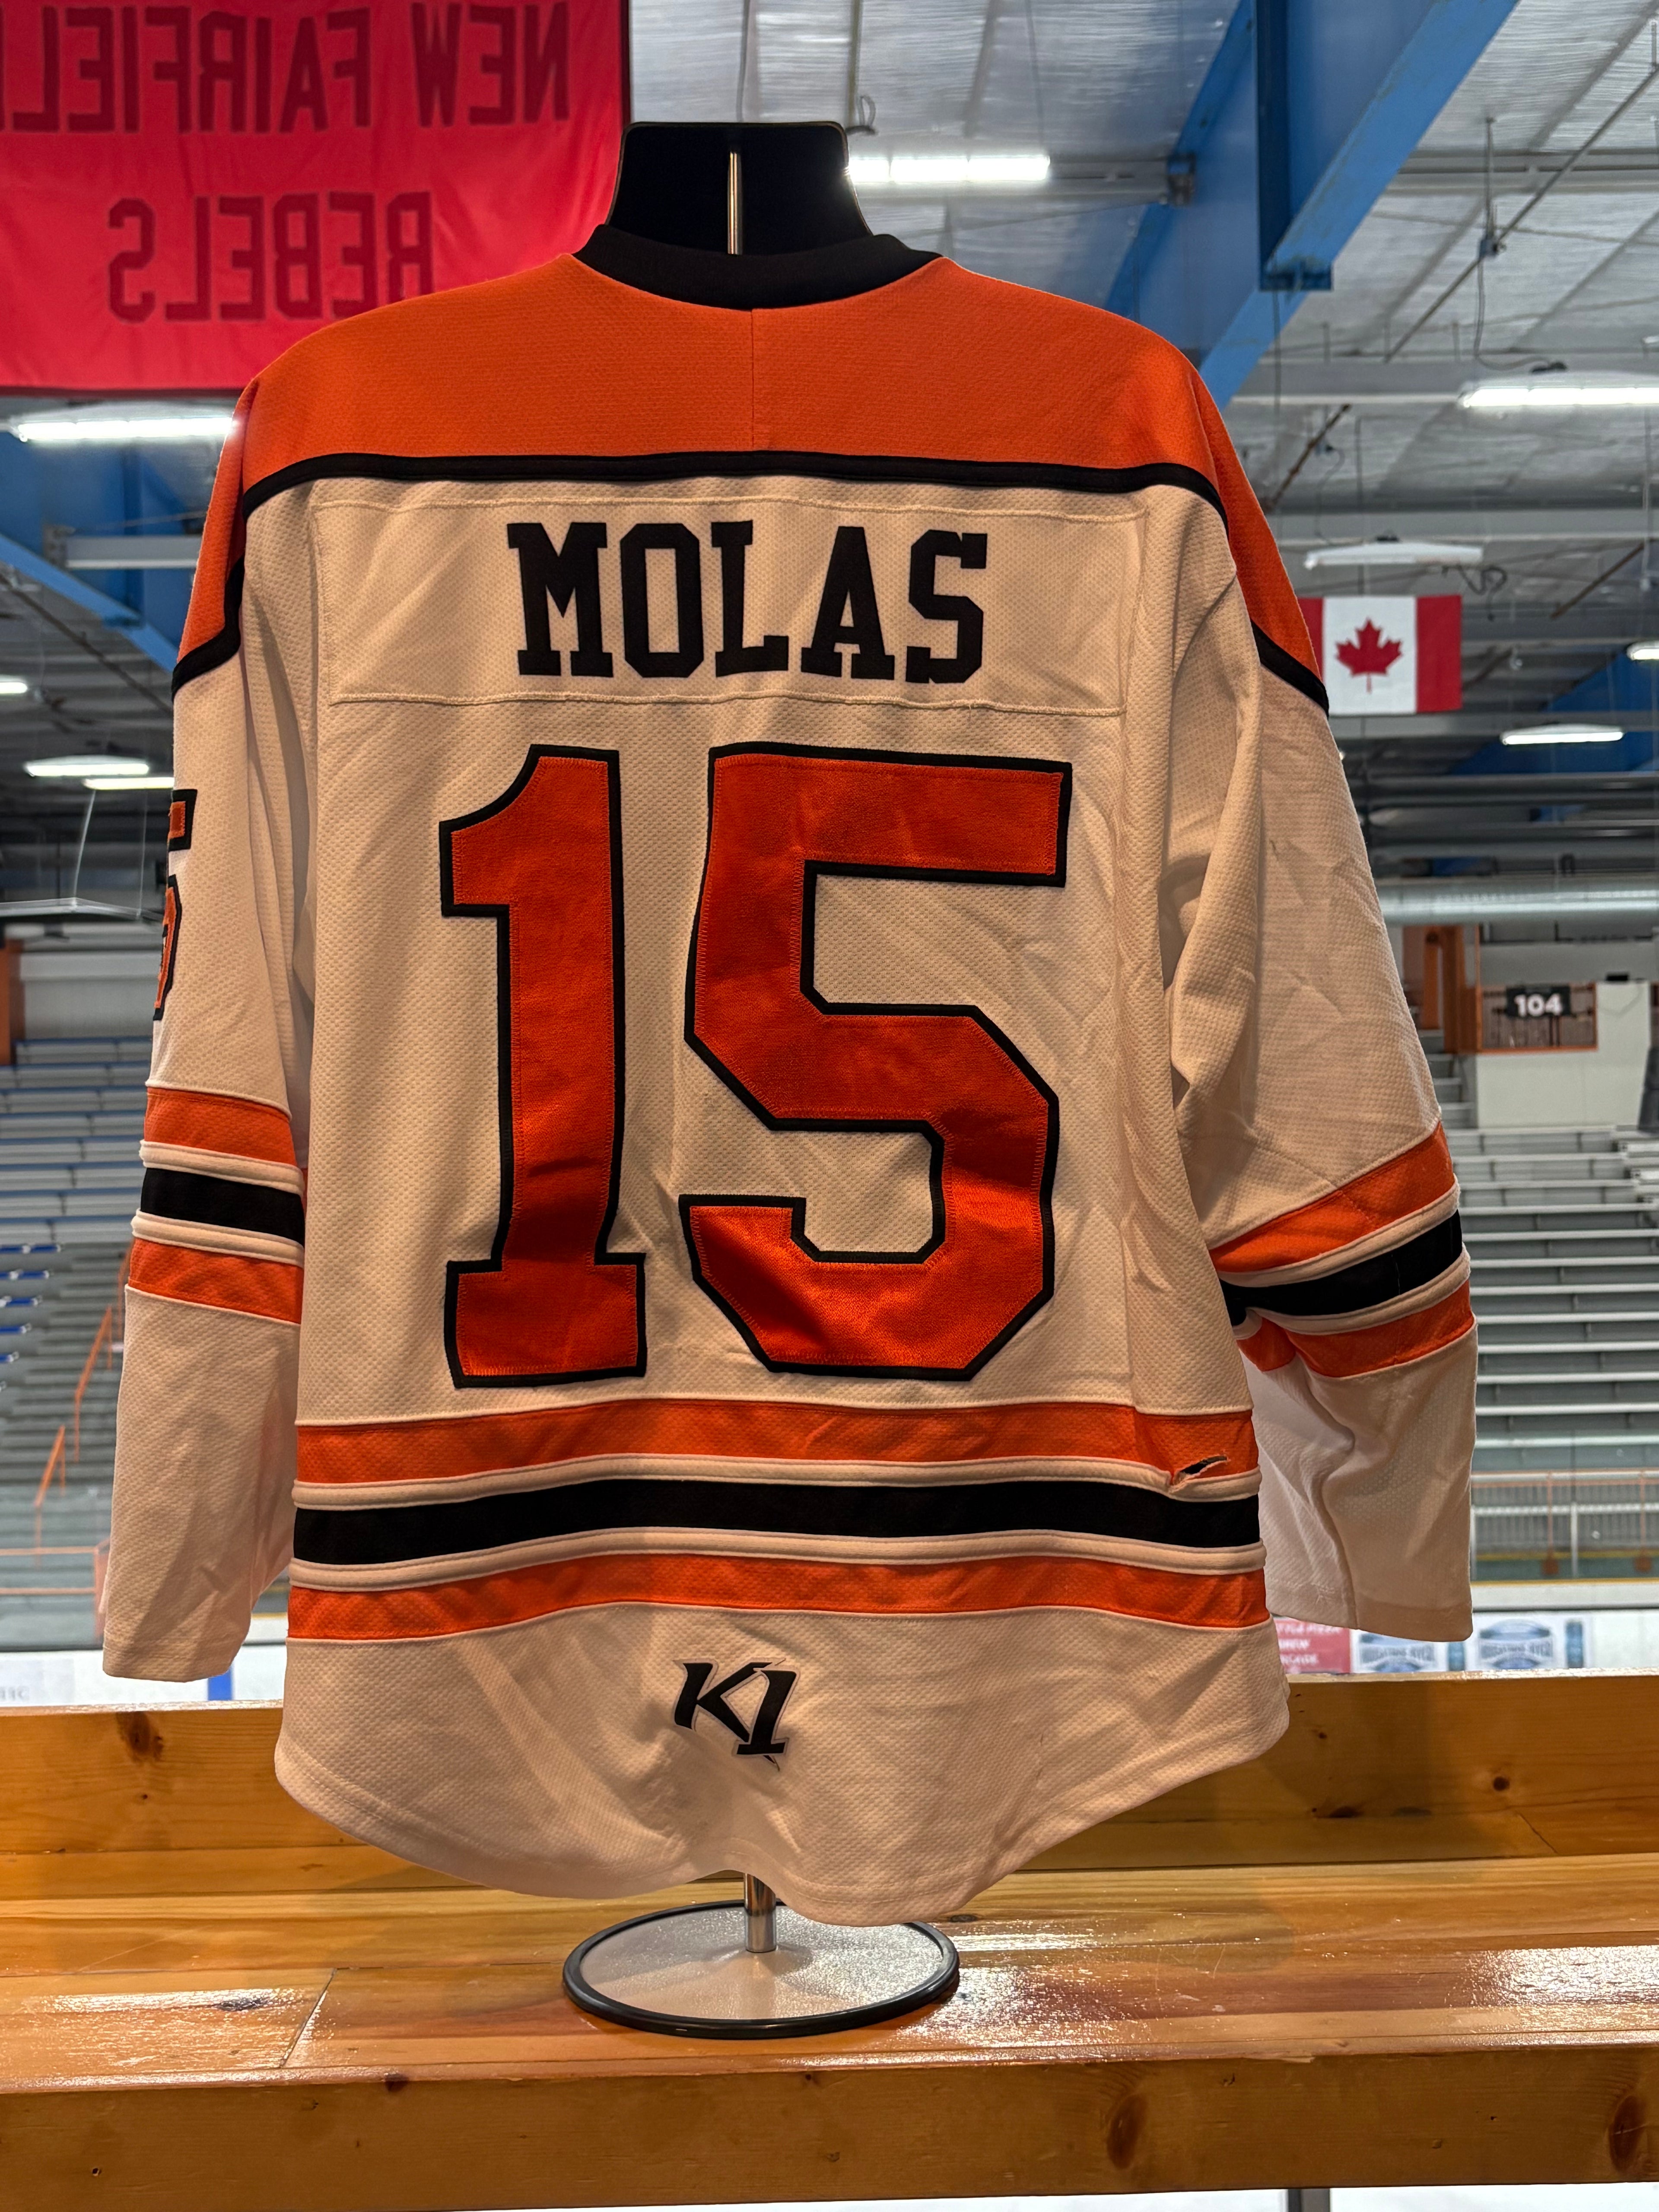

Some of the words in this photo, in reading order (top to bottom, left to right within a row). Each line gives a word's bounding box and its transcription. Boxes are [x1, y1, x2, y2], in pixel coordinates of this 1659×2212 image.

[507, 519, 988, 683] MOLAS
[439, 741, 1072, 1389] 15
[1514, 993, 1563, 1017] 104
[673, 1658, 800, 1767] K1
